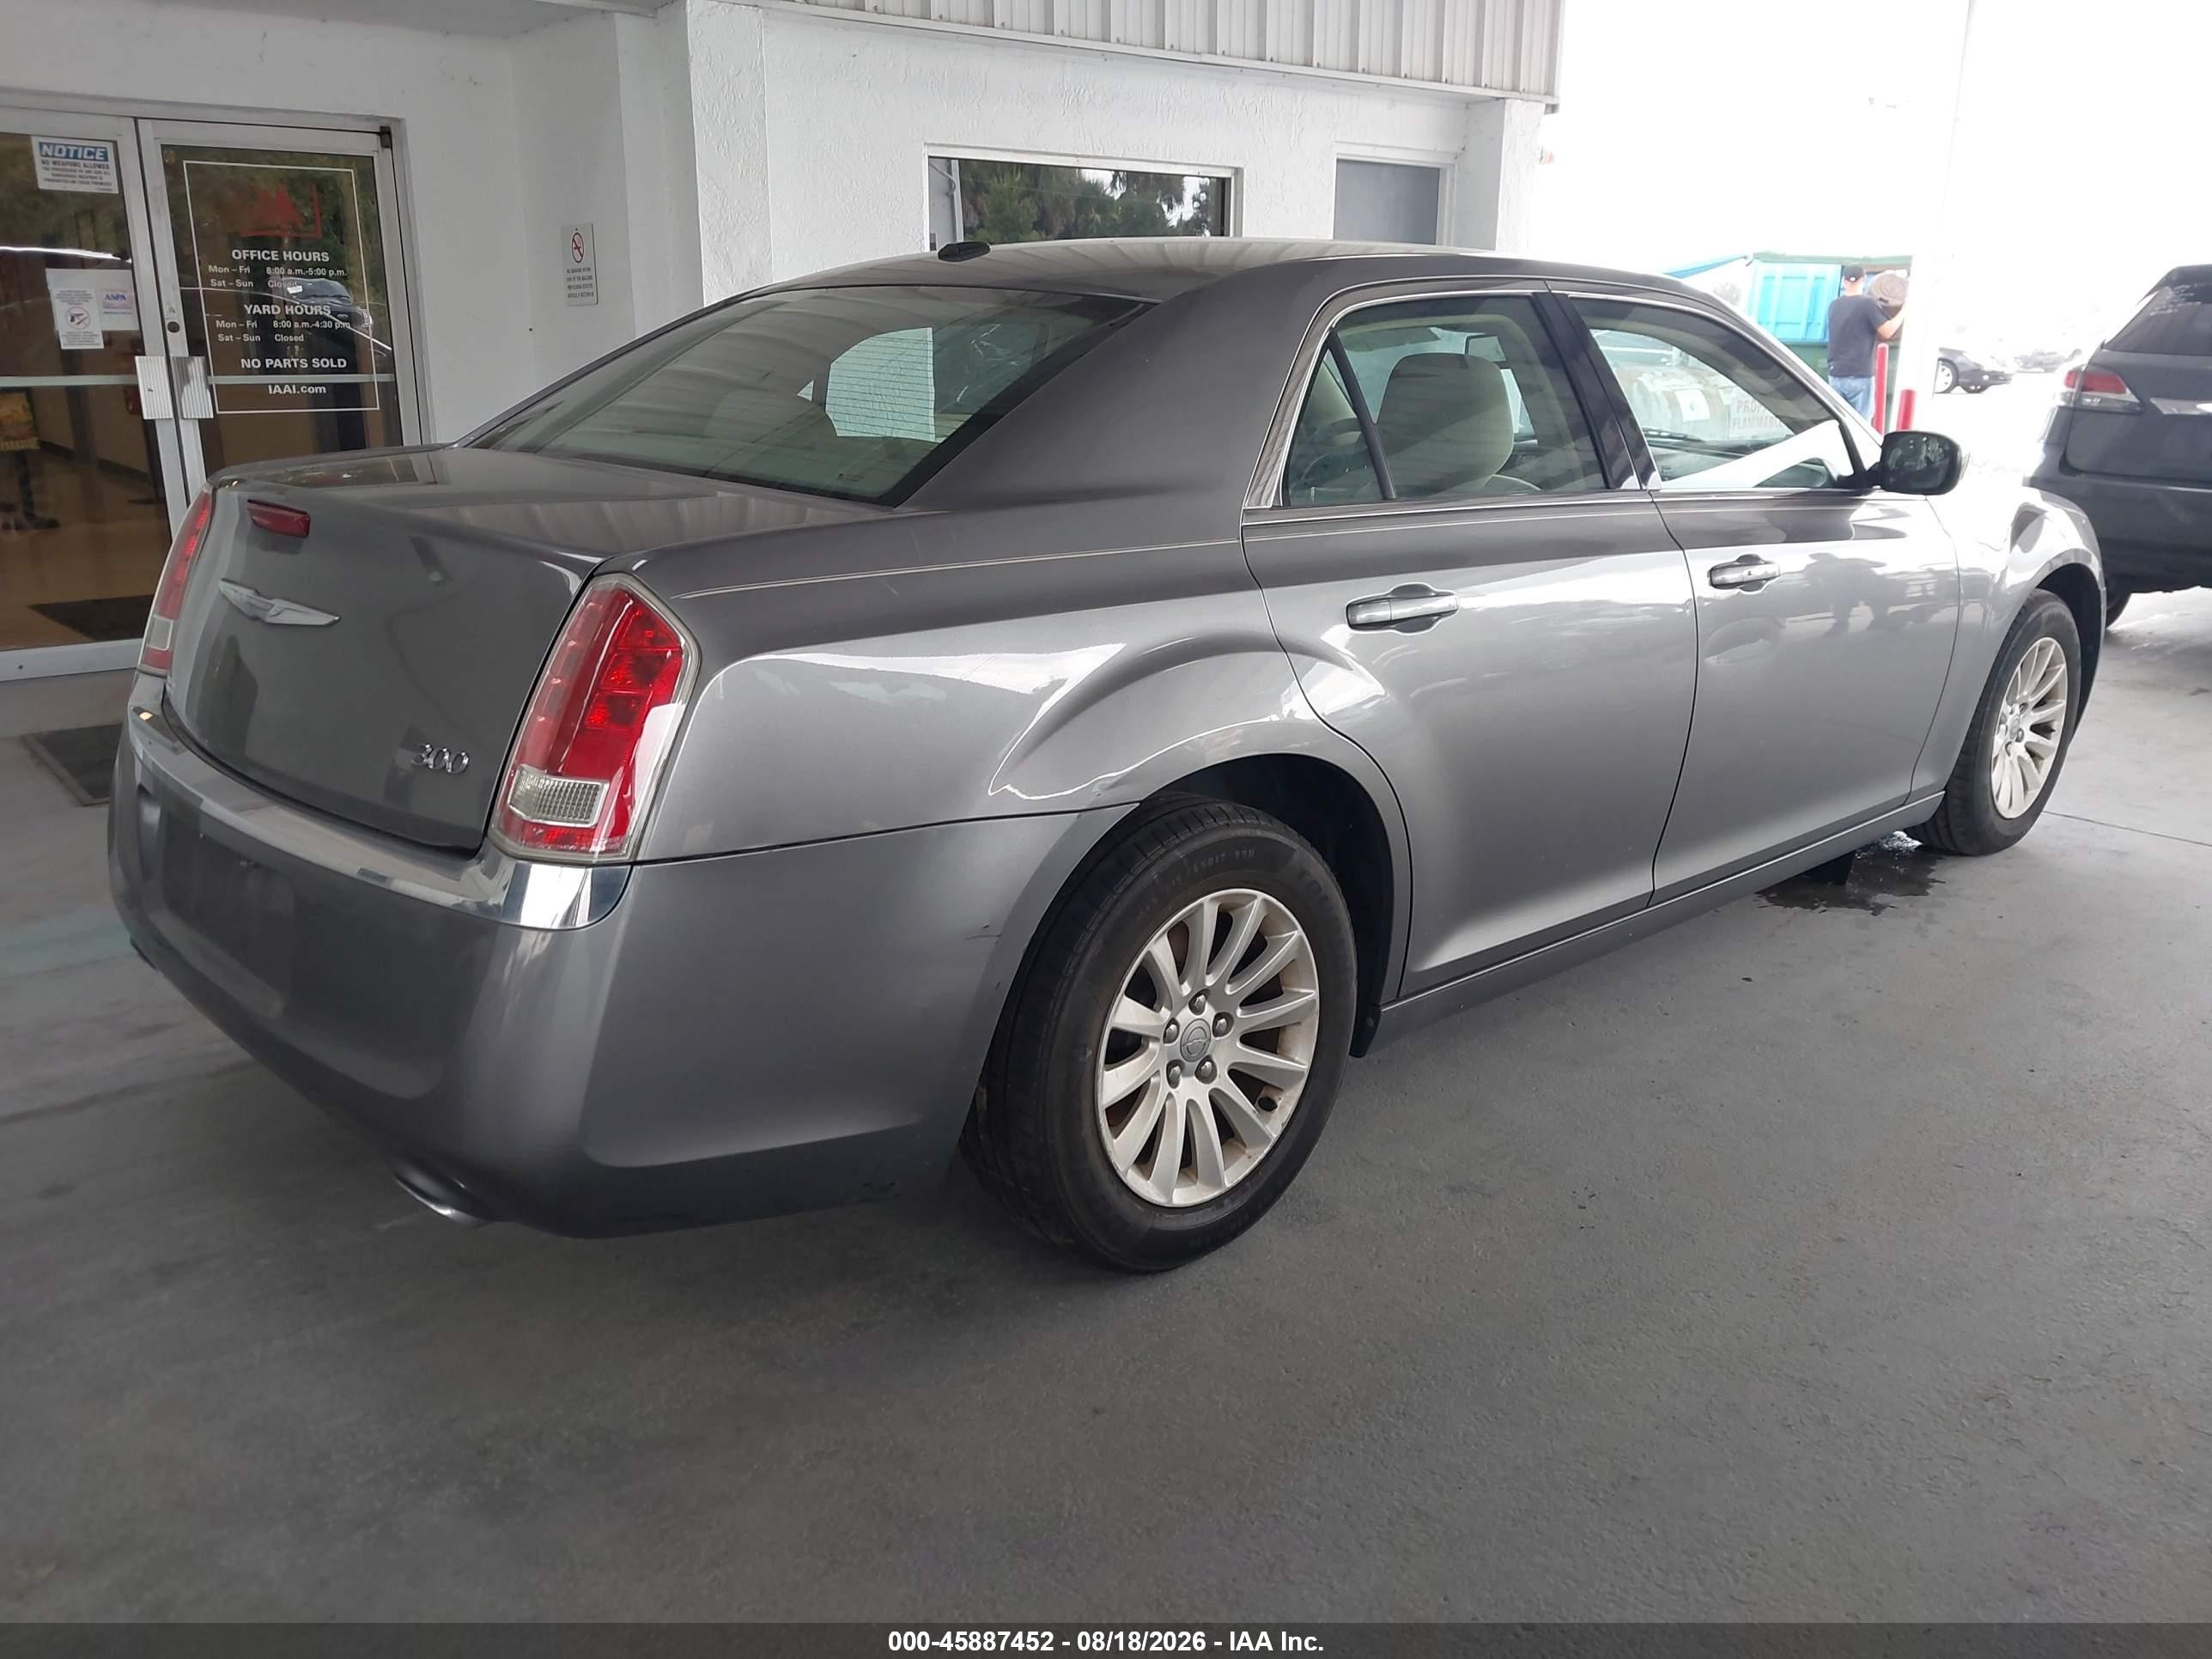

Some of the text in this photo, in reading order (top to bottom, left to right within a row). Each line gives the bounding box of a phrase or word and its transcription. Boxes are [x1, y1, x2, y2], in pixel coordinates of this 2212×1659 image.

[41, 143, 106, 161] NOTICE
[232, 249, 330, 262] OFFICE HOURS
[208, 264, 229, 274] Mon
[239, 265, 251, 274] Fri
[266, 266, 285, 275] 8:00
[329, 269, 347, 277] p.m.
[210, 278, 226, 288] Sat
[235, 278, 253, 288] Sun
[267, 279, 298, 289] Cloed
[244, 304, 331, 315] YARD HOURS
[216, 320, 237, 329] Mon
[246, 320, 258, 329] Fri
[273, 319, 292, 329] 8:00
[218, 333, 234, 342] Sat
[243, 333, 261, 342] Sun
[275, 333, 304, 342] Closed
[240, 357, 347, 368] NO PARTS SOLD
[268, 384, 326, 395] IAAI.com
[411, 744, 470, 774] 300
